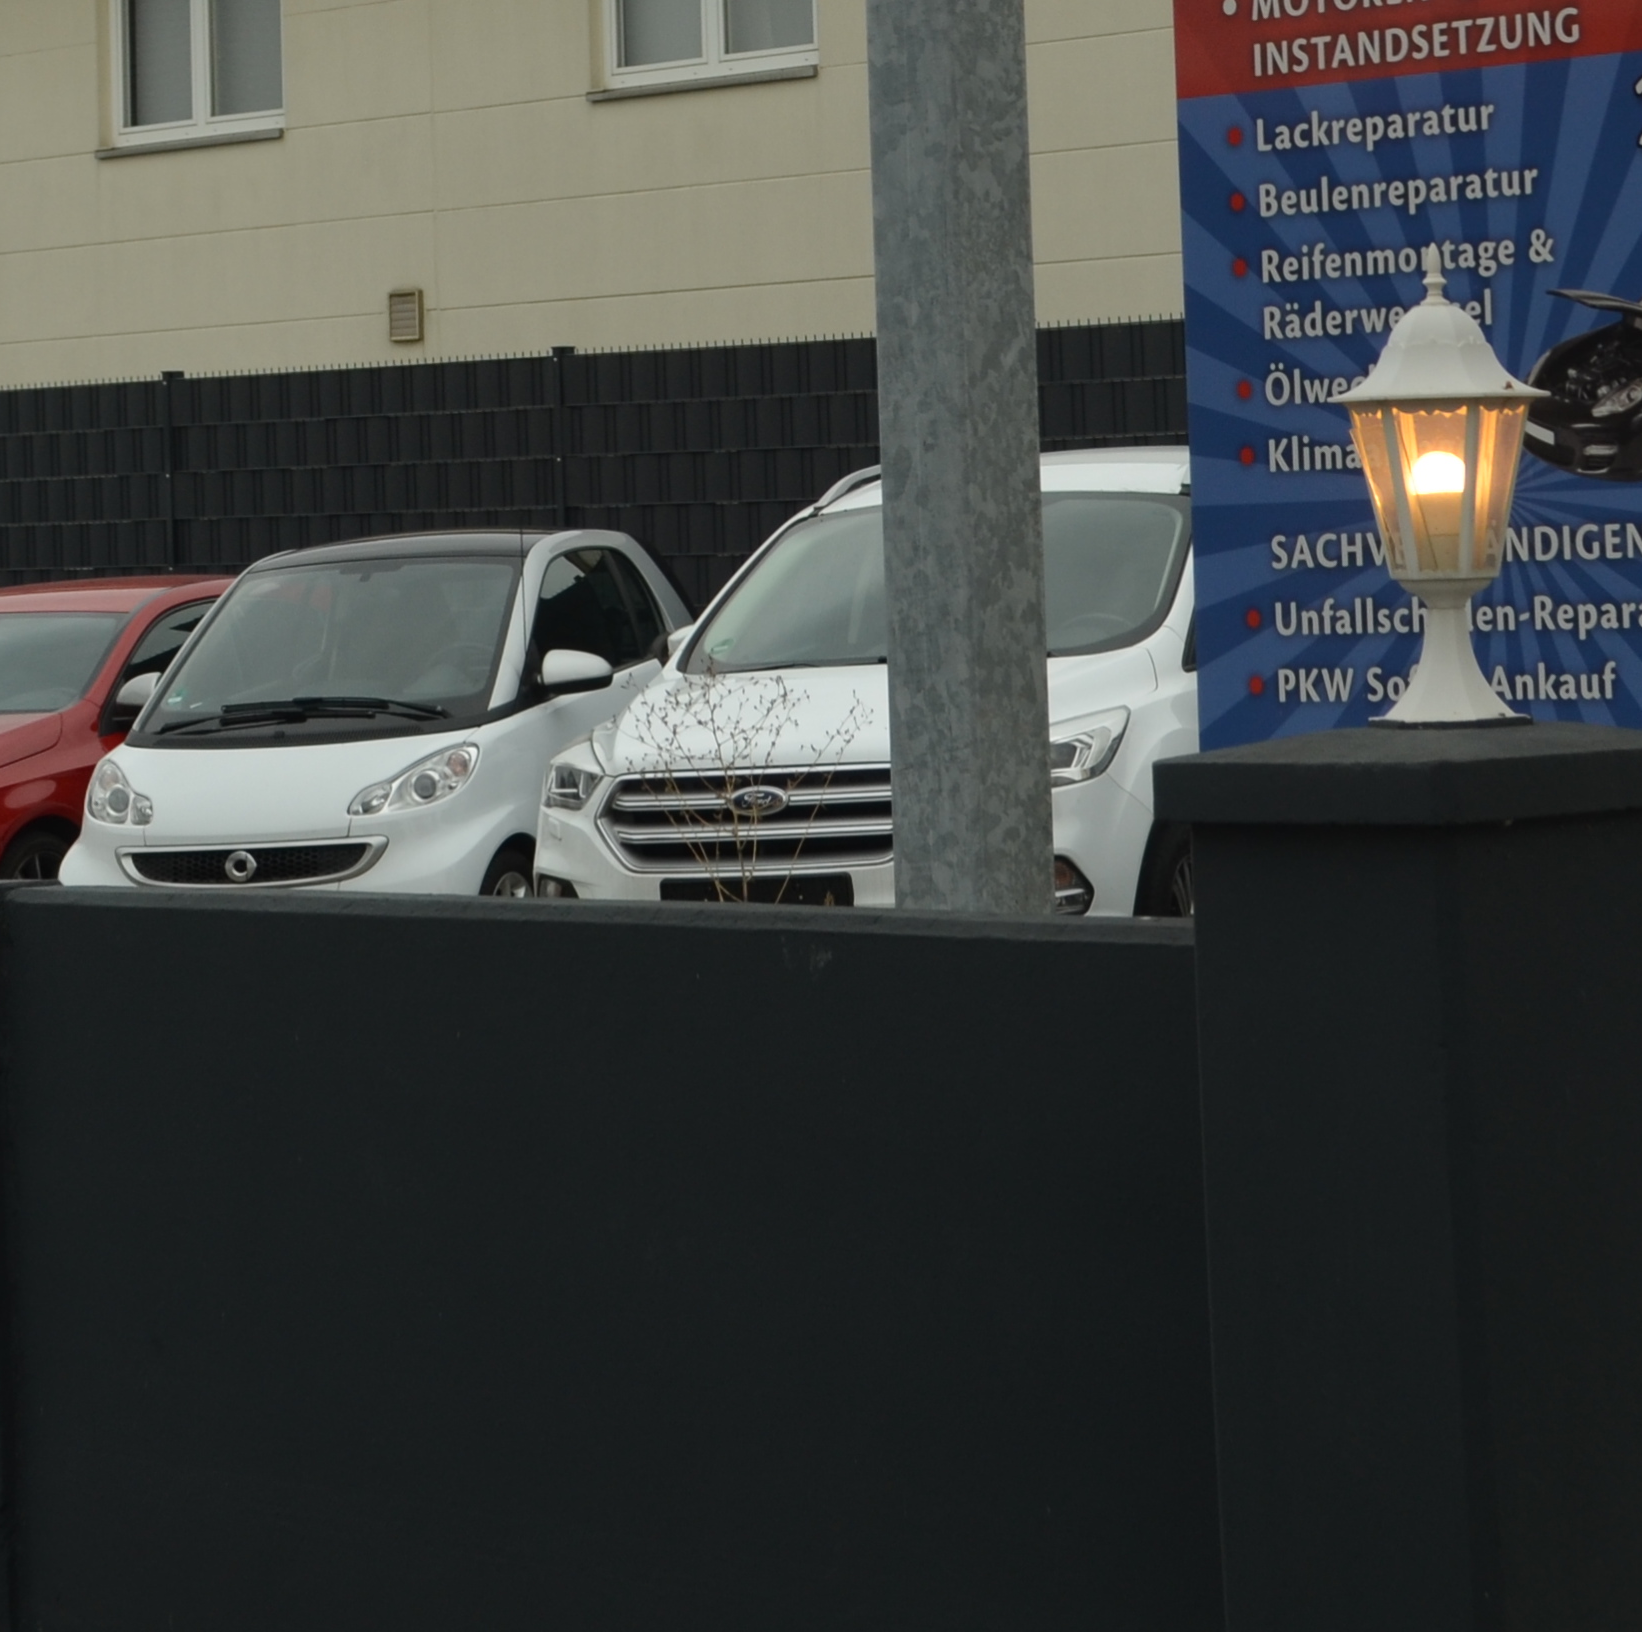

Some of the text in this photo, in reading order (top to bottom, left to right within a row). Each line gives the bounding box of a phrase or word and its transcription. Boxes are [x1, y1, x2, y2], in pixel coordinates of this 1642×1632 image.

[1253, 7, 1580, 77] INSTANDSETZUNG
[1256, 104, 1494, 152] Lackreparatur
[1258, 168, 1538, 218] Beulenreparatur
[1529, 228, 1554, 263] &
[1263, 288, 1492, 340] Räderweel
[1277, 667, 1354, 703] PKW
[1490, 662, 1617, 701] Ankauf
